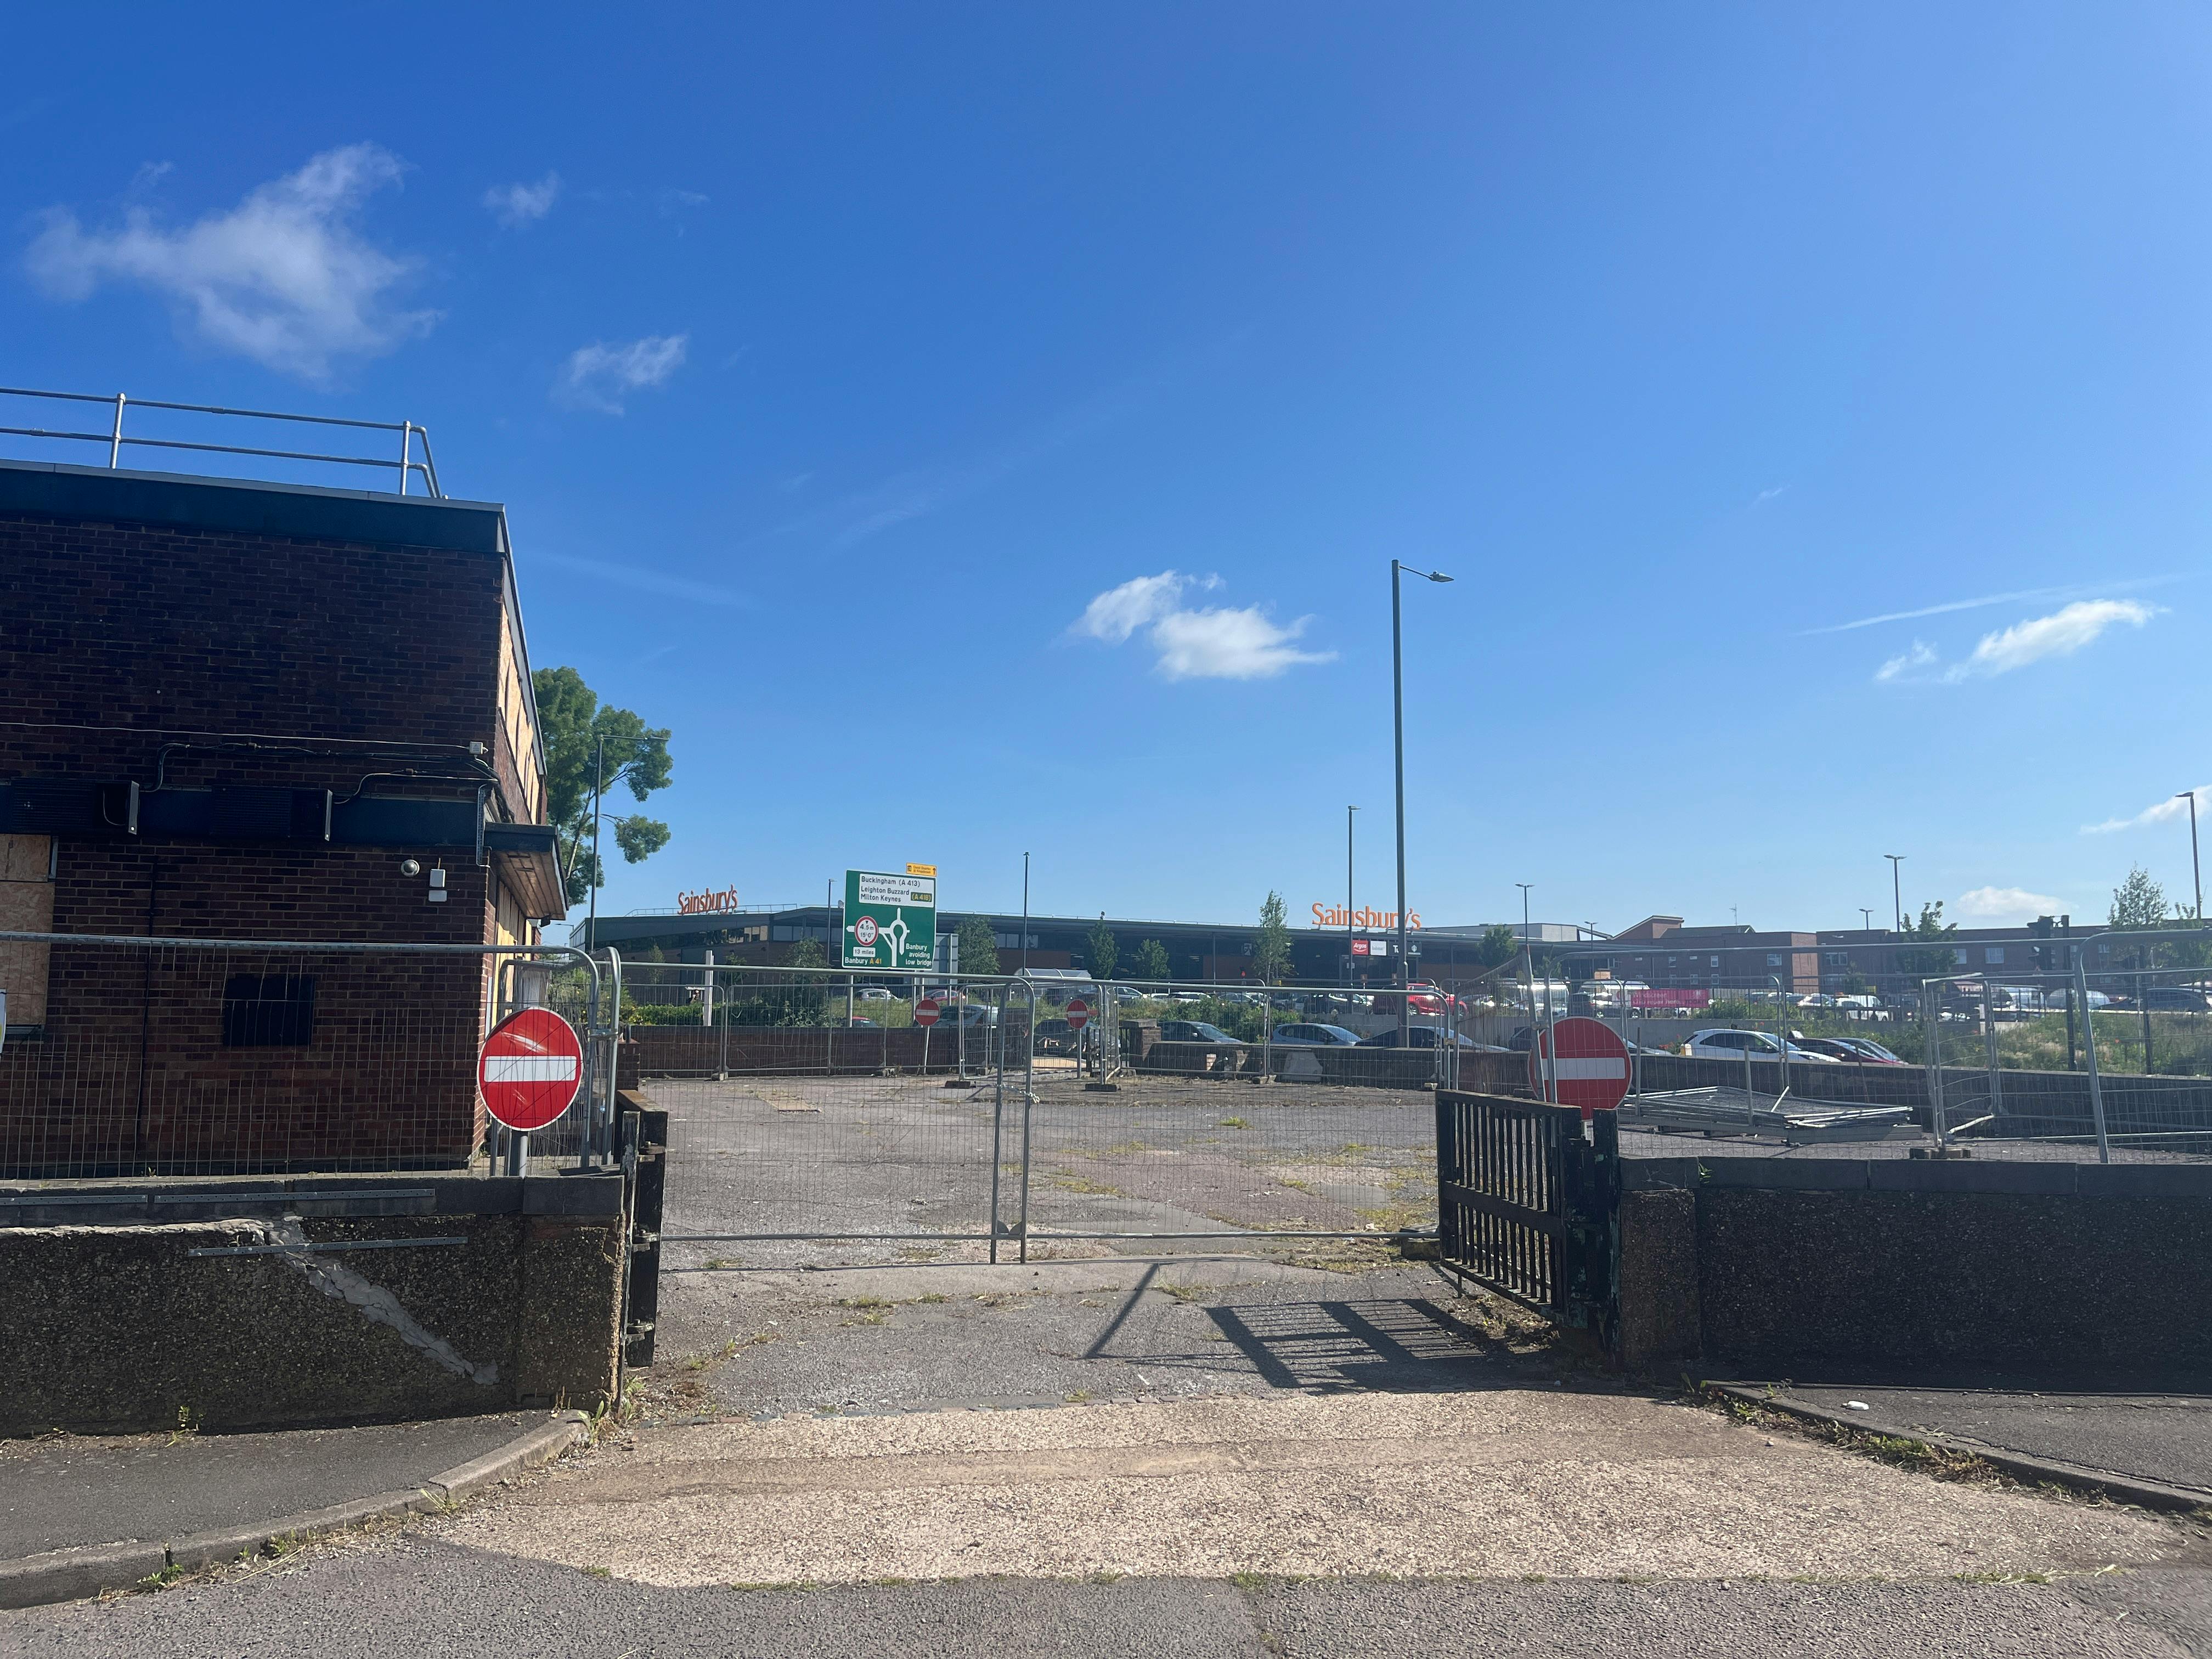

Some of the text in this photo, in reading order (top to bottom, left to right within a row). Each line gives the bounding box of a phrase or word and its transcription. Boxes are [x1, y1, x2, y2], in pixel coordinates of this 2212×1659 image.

[861, 876, 896, 885] Buckingham
[677, 884, 738, 913] Sainsbury's
[906, 943, 927, 951] Banbury
[844, 957, 868, 966] Banbury
